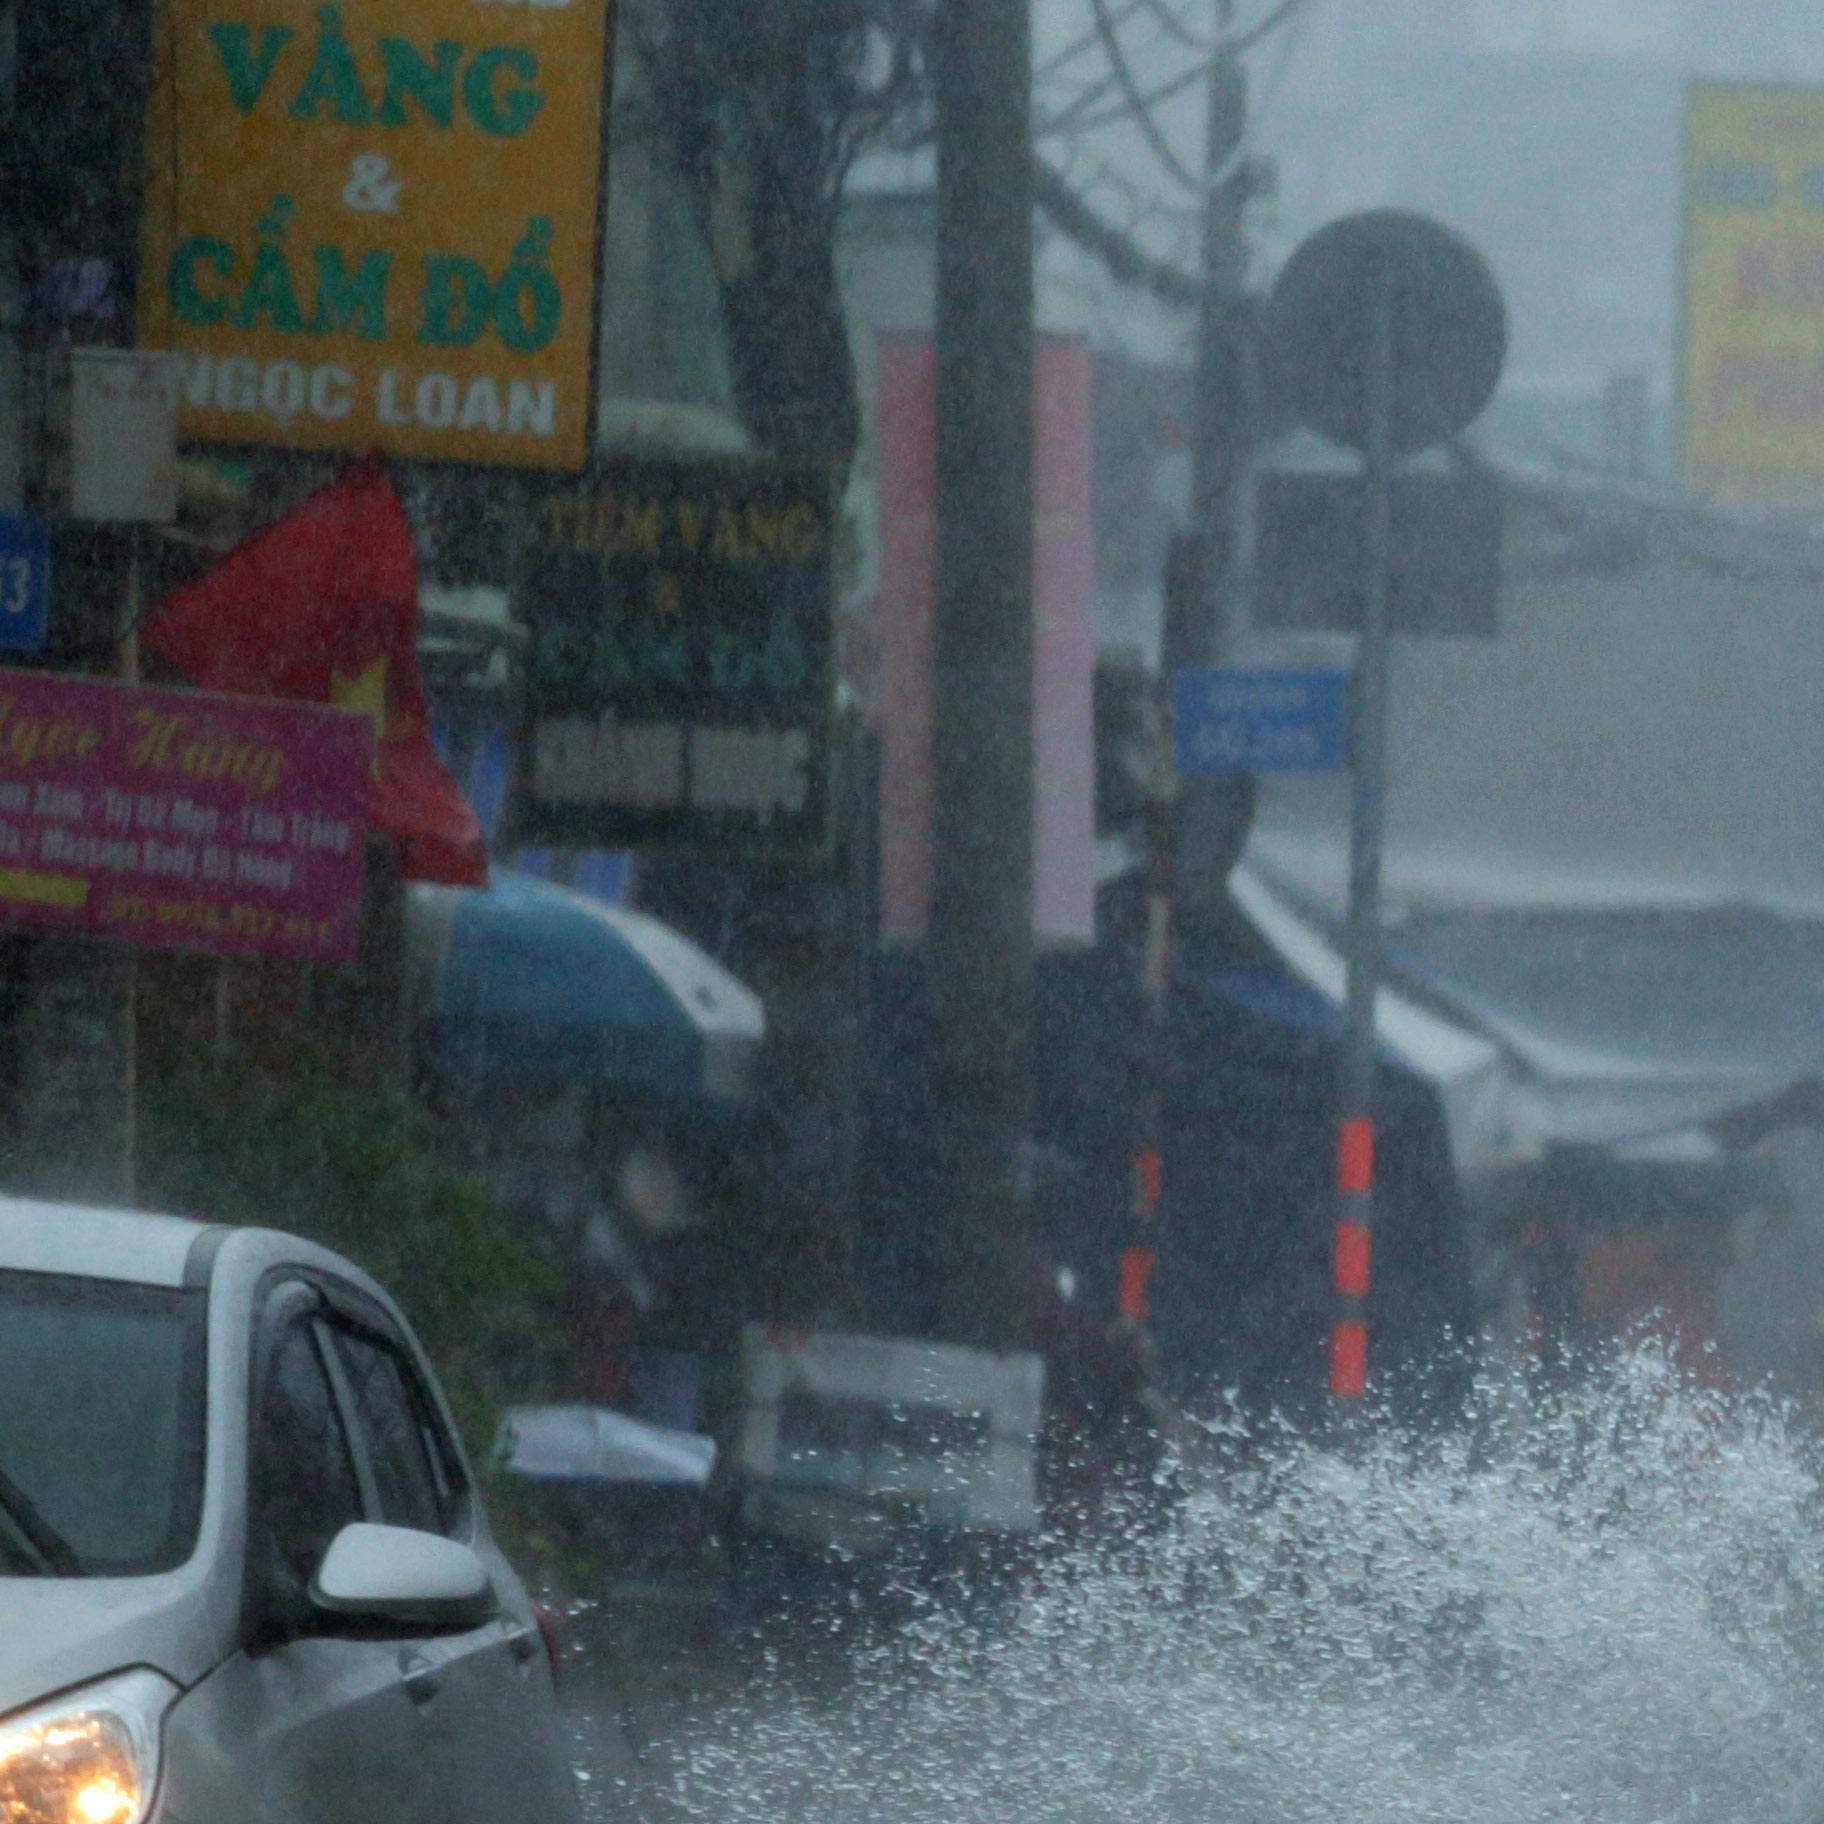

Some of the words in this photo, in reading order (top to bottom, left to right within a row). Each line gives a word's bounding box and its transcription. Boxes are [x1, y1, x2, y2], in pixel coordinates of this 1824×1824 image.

[208, 4, 544, 137] VÀNG
[342, 152, 404, 213] &
[174, 354, 354, 428] NGỌC
[377, 366, 557, 437] LOAN
[0, 554, 32, 614] 3
